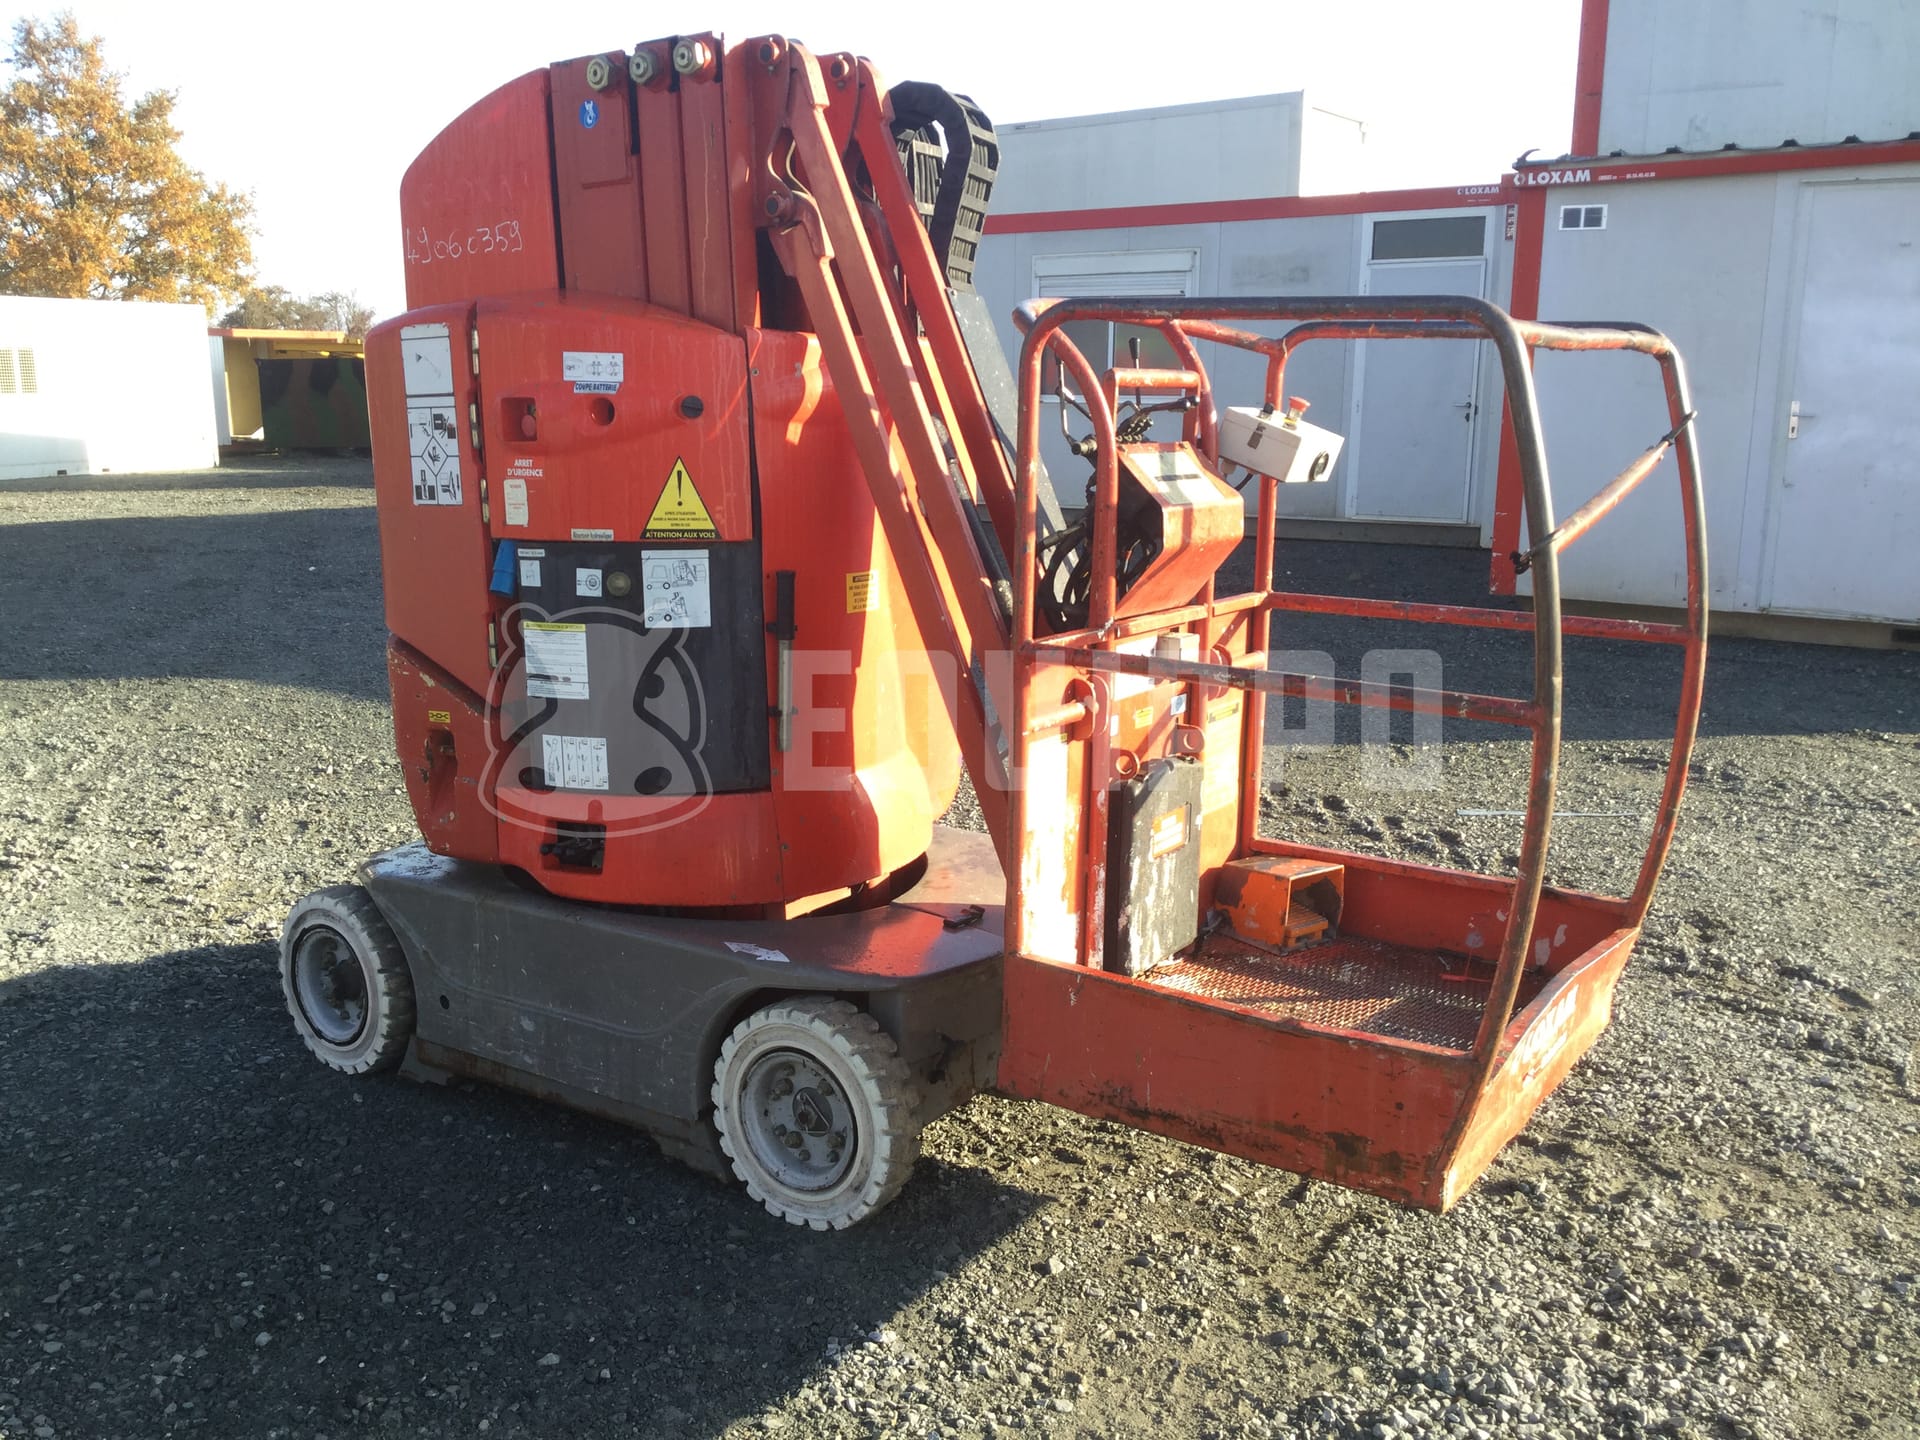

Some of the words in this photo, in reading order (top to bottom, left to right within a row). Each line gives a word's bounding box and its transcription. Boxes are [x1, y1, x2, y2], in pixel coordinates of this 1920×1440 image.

[1527, 170, 1591, 185] LOXAM
[1465, 186, 1499, 195] LOXAM
[507, 468, 543, 477] D'URGENCE
